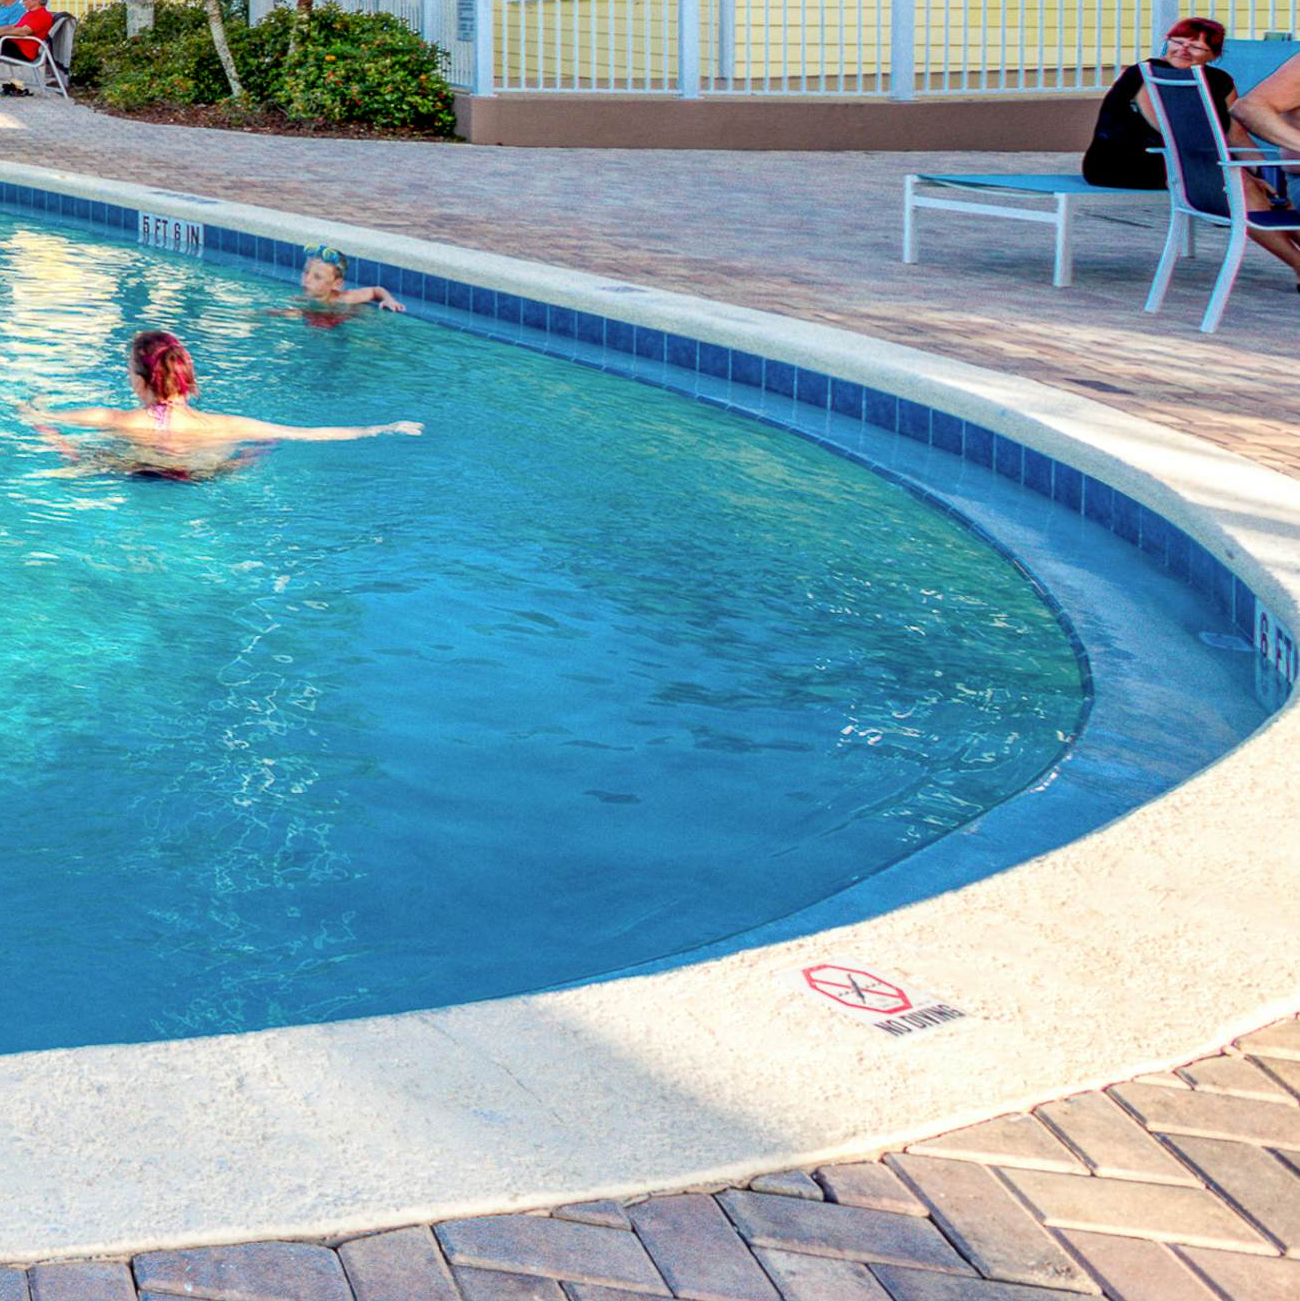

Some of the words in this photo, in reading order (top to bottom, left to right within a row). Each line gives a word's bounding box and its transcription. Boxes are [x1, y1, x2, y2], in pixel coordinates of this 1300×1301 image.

[142, 215, 150, 237] 5
[154, 218, 168, 237] FT
[174, 222, 181, 241] 6
[186, 224, 200, 245] IN
[1260, 610, 1269, 658] 6
[1275, 626, 1293, 683] FT
[872, 1019, 913, 1038] NO
[899, 1003, 967, 1029] DIVING
